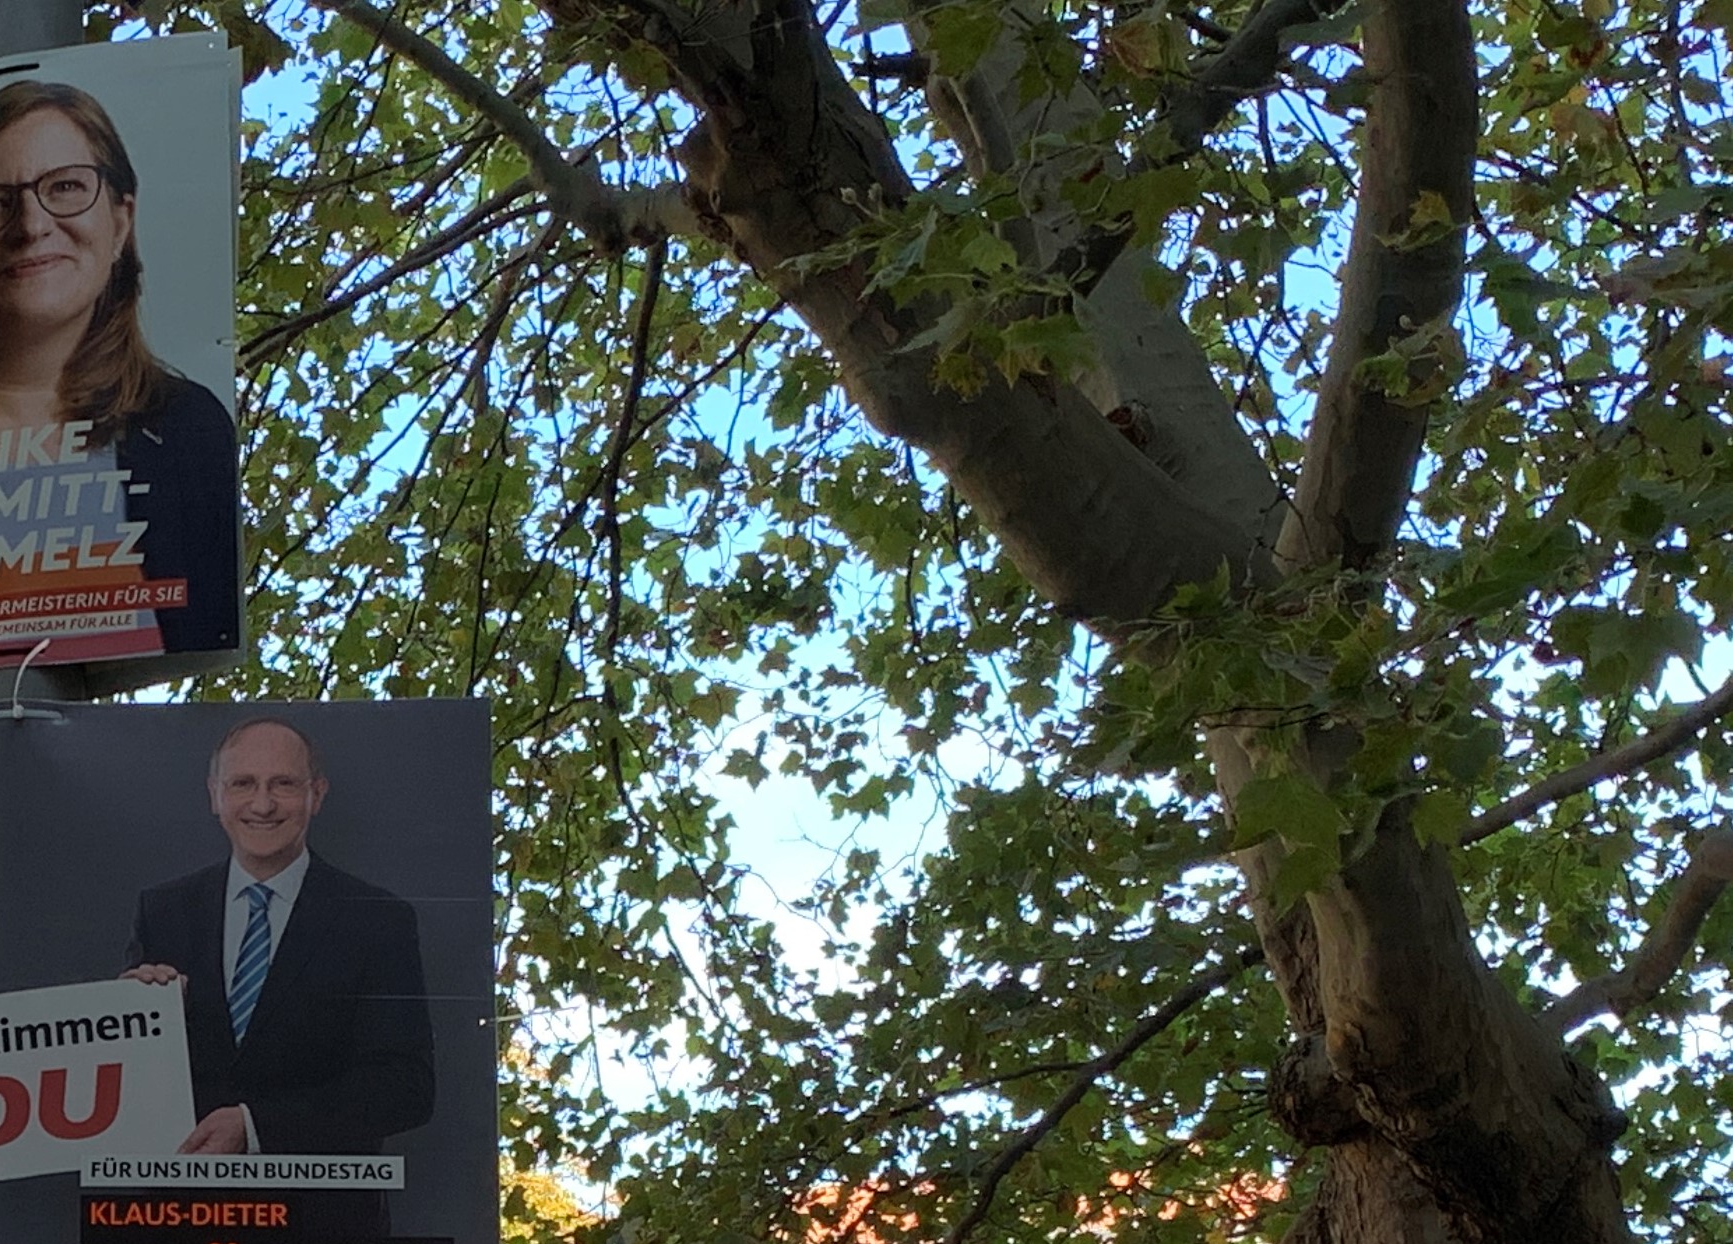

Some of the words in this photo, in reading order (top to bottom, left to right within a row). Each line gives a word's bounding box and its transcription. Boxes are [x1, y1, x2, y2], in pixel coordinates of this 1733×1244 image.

[113, 584, 151, 604] FÜR
[155, 584, 184, 602] SIE
[69, 614, 97, 632] FÜR
[98, 613, 133, 627] ALLE
[90, 1157, 132, 1181] FÜR
[136, 1160, 182, 1181] UNS
[185, 1162, 208, 1181] IN
[213, 1163, 257, 1182] DEN
[264, 1162, 394, 1182] BUNDESTAG
[89, 1201, 289, 1229] KLAUS-DIETER
